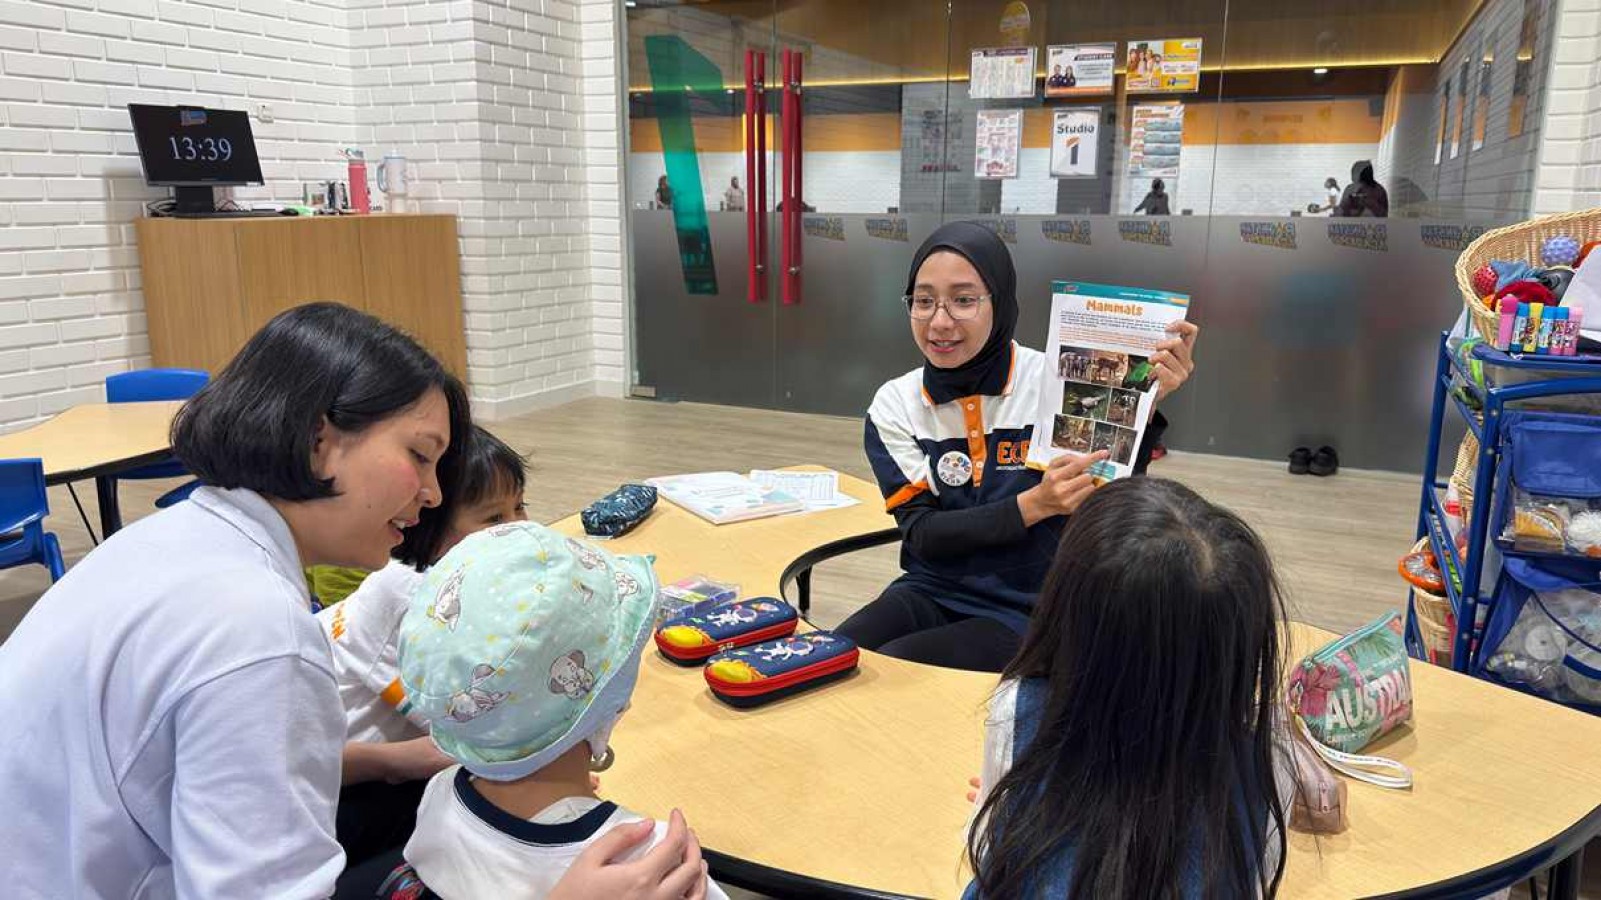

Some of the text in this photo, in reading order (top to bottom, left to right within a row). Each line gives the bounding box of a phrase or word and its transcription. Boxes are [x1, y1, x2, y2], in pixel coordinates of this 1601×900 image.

[1057, 122, 1095, 134] Studio
[169, 136, 232, 161] 13:39
[1065, 136, 1080, 165] 1
[1086, 299, 1144, 317] Mammals
